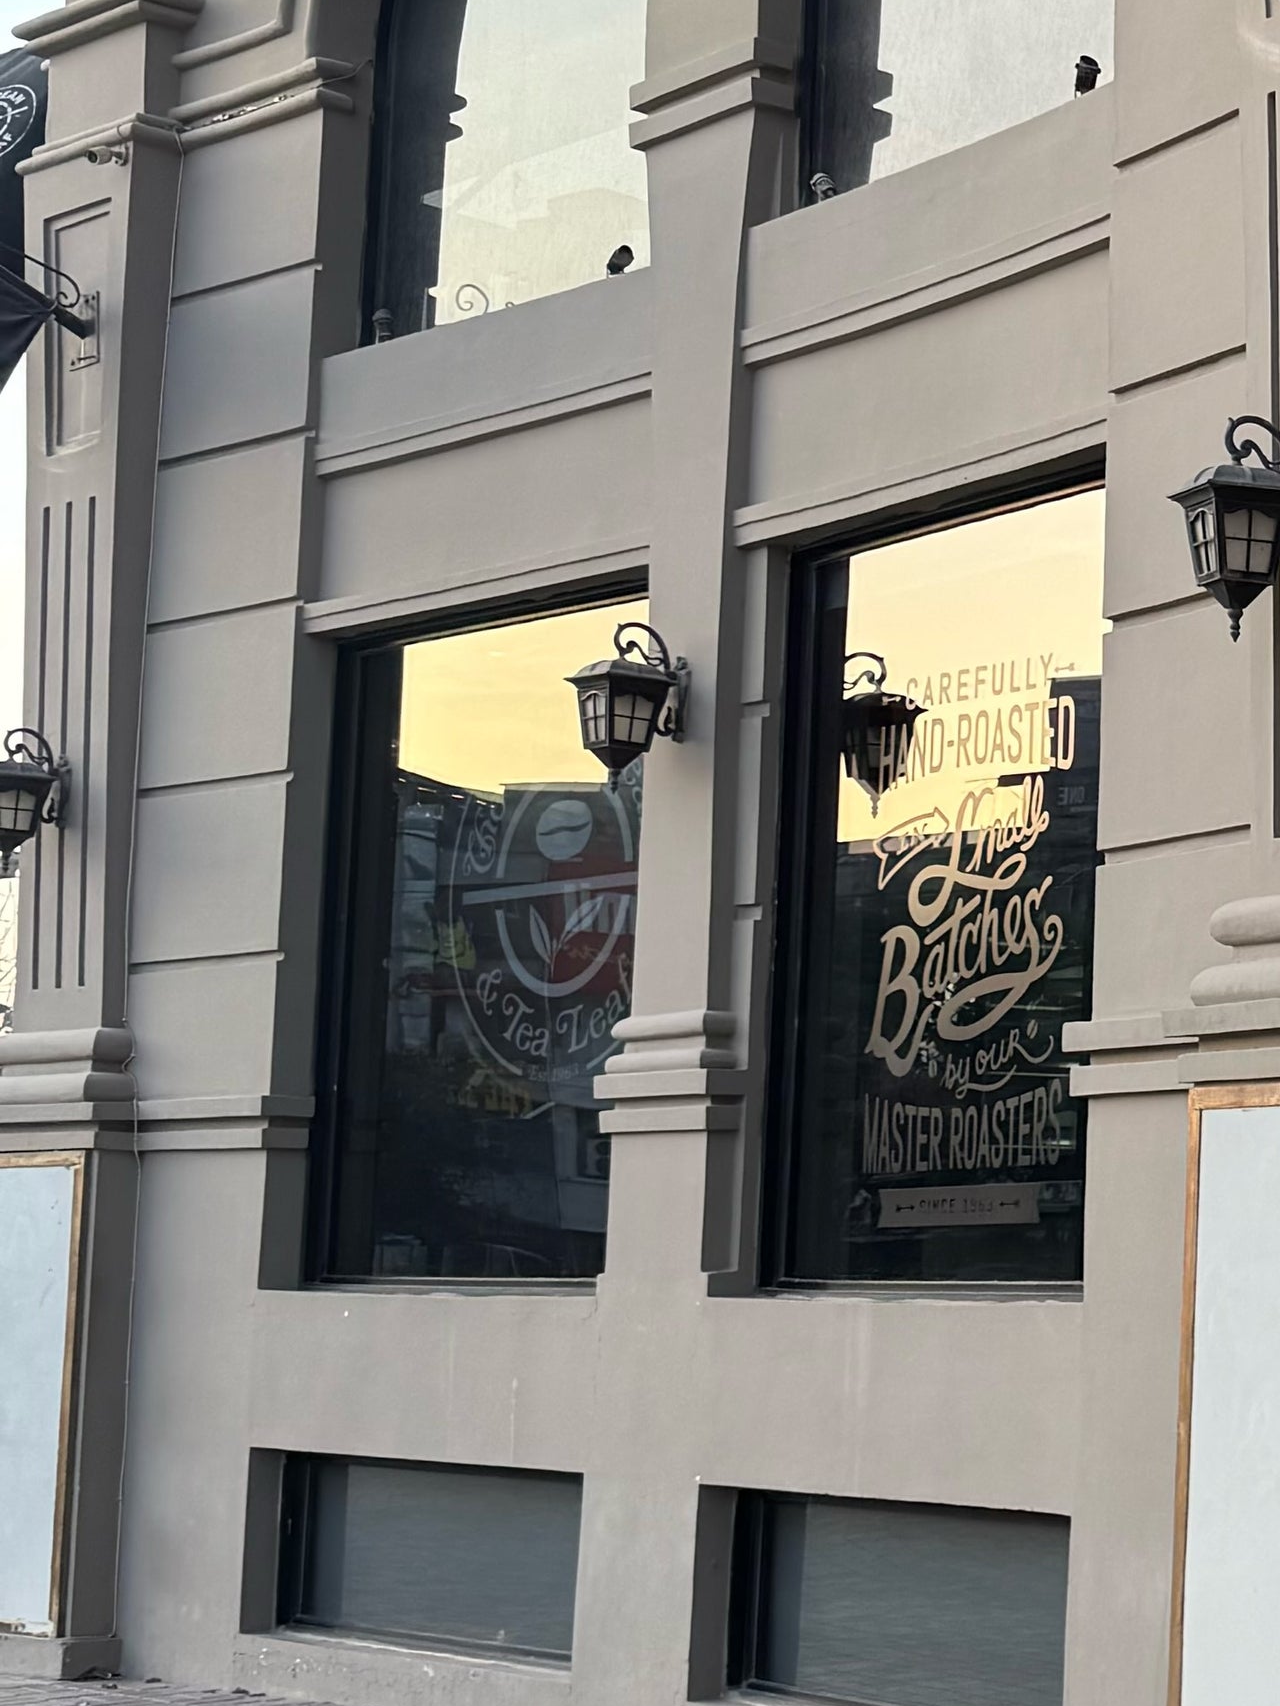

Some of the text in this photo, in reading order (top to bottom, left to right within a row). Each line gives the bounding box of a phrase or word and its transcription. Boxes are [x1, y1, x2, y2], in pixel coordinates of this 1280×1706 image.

[905, 653, 1053, 710] CAREFULLY
[879, 695, 1076, 796] HAND-ROASTED
[908, 775, 1049, 927] Small
[864, 876, 1064, 1078] Batches
[502, 994, 550, 1057] Tea
[940, 1053, 988, 1100] by
[862, 1080, 1062, 1174] MASTER ROASTERS
[919, 1198, 956, 1214] SINCE
